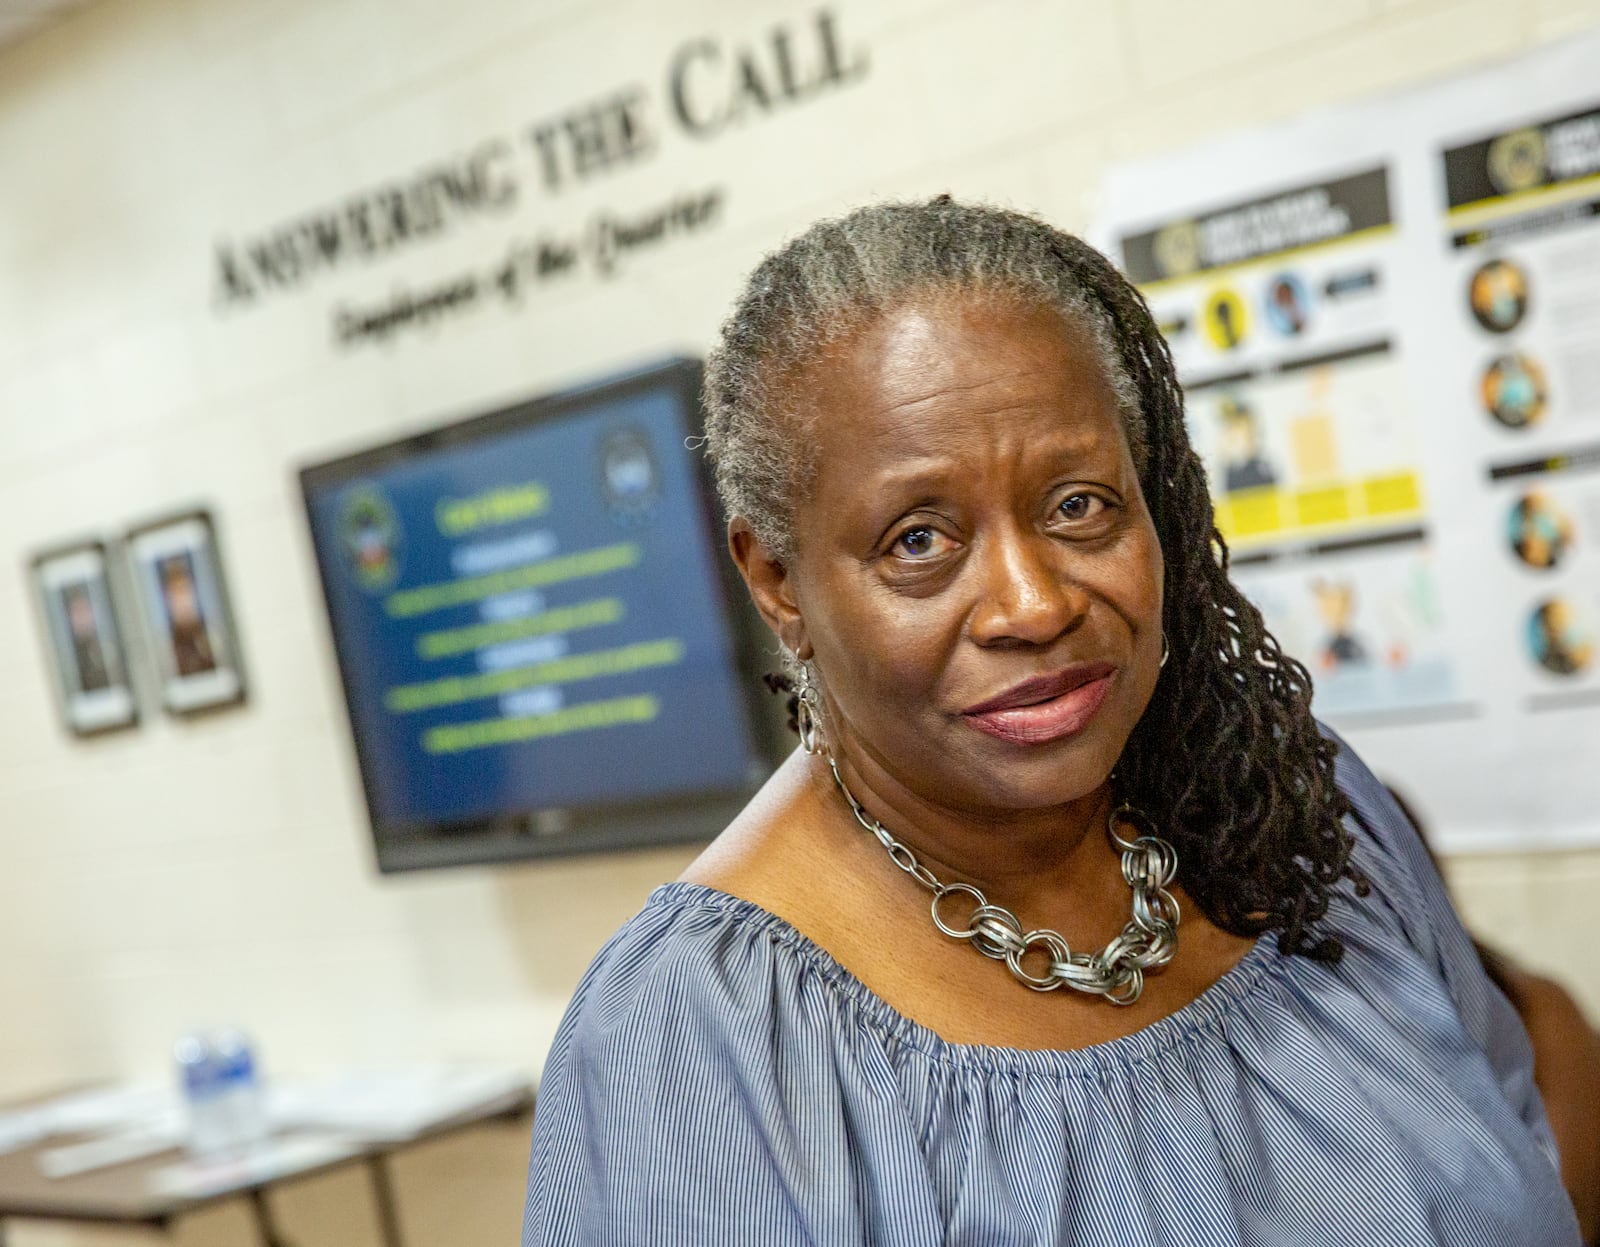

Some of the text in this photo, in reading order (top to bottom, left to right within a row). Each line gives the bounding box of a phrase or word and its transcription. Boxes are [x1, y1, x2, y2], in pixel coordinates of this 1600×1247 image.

[212, 142, 515, 306] ANSWERING
[529, 86, 656, 190] THE
[494, 238, 531, 306] of
[536, 231, 577, 277] the
[586, 185, 724, 278] Quarter
